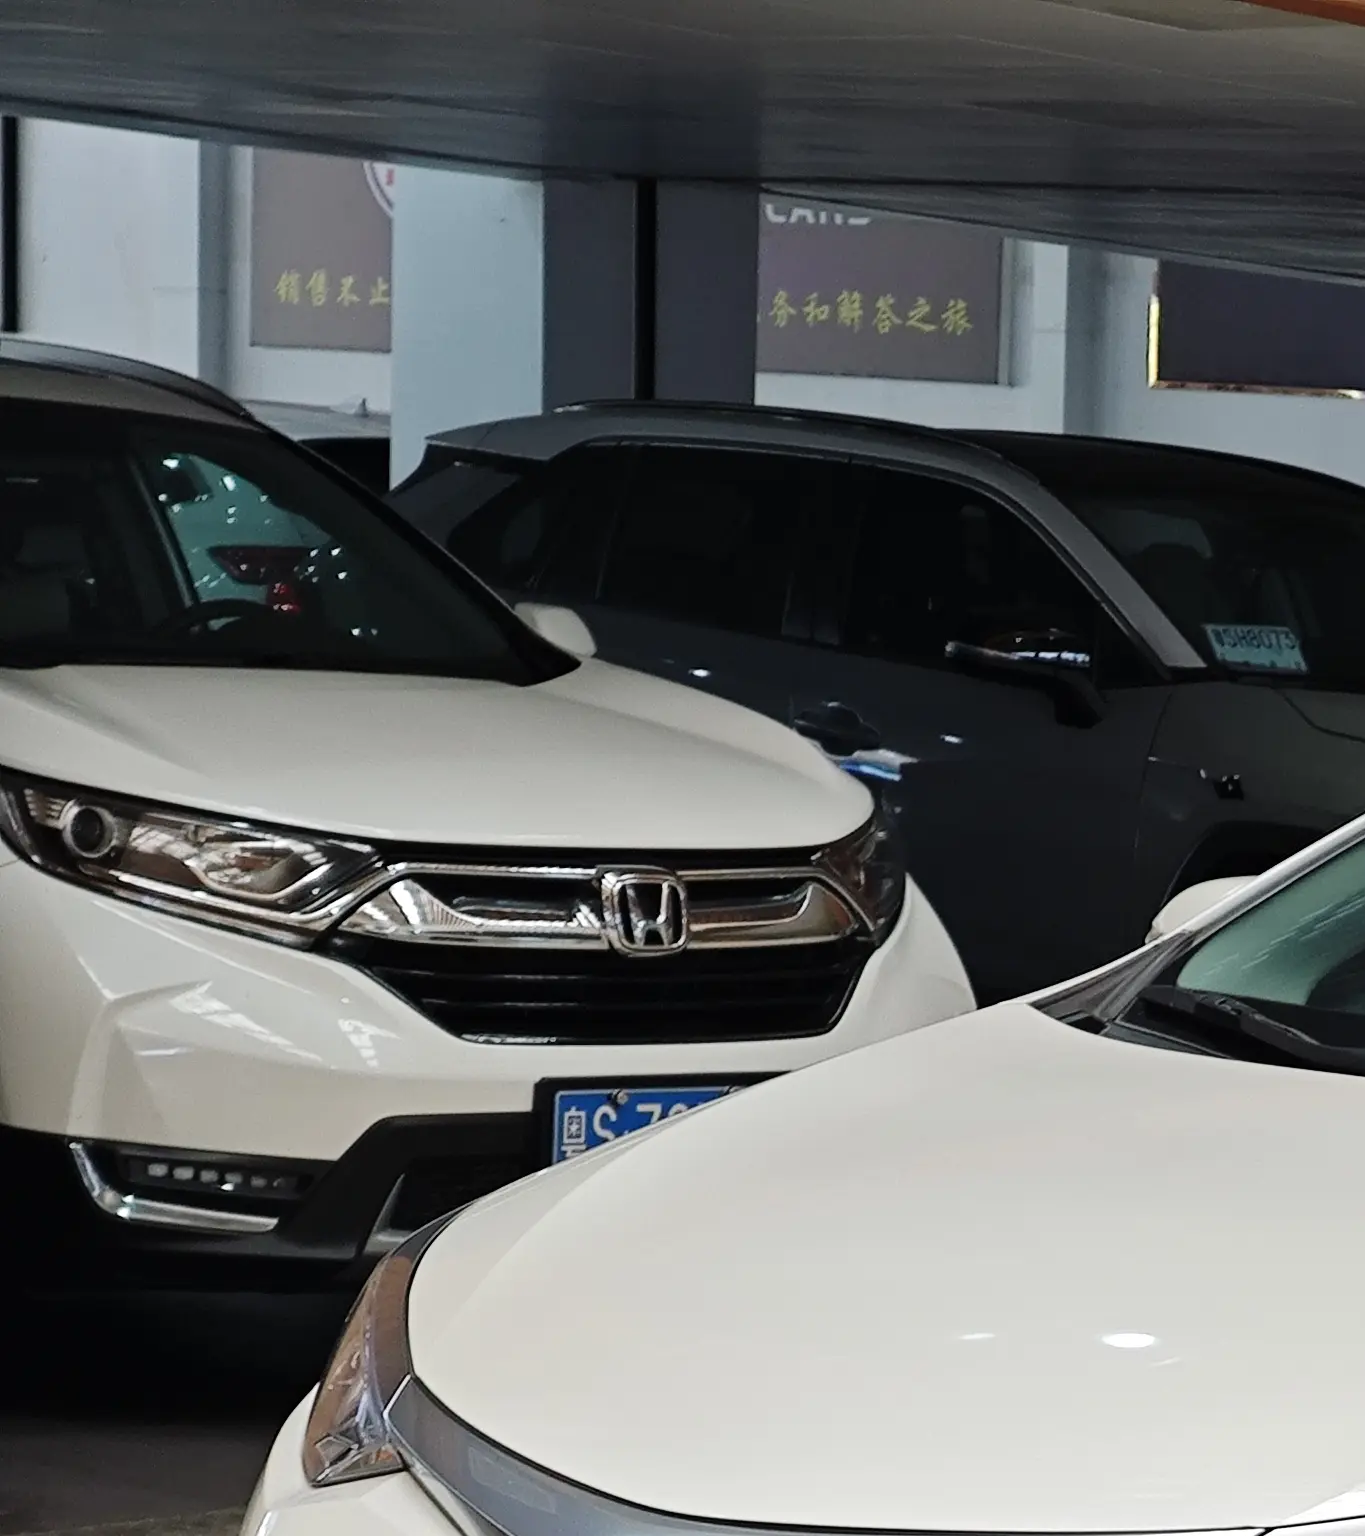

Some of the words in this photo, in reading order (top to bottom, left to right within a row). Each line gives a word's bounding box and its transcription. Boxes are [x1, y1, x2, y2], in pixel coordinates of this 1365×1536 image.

[758, 289, 974, 336] 务和解答之旅
